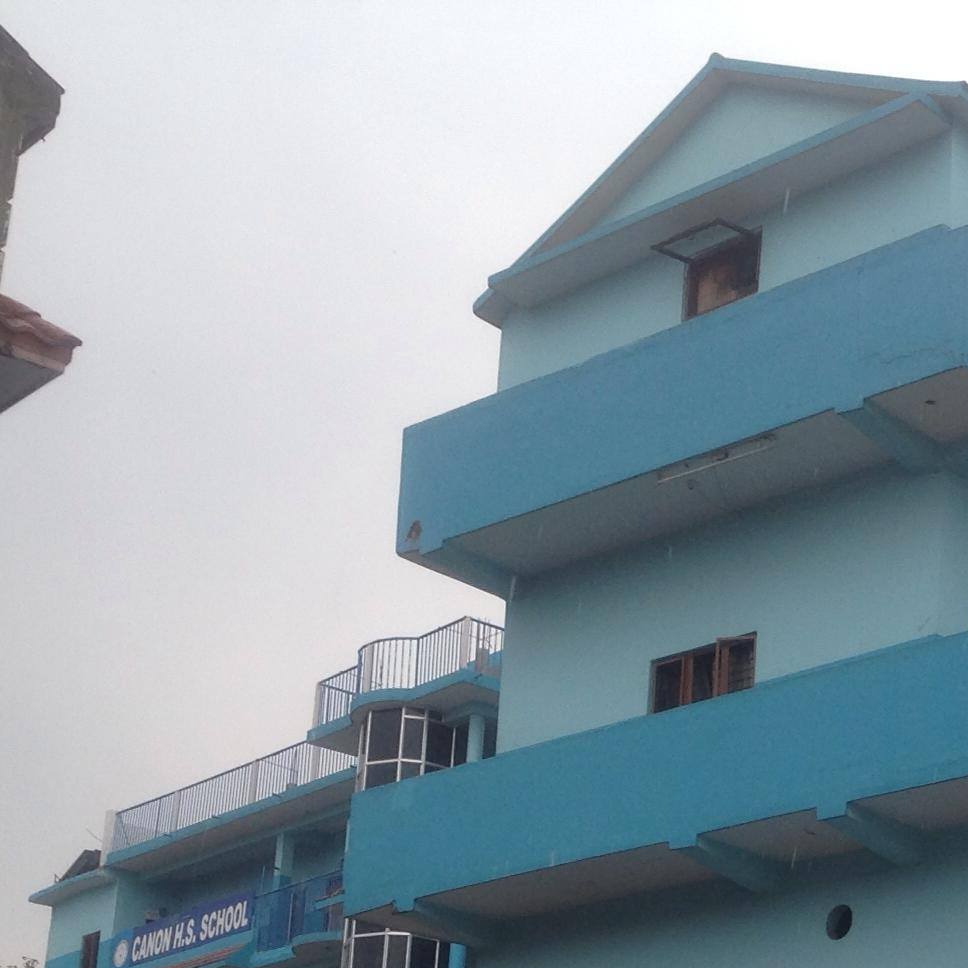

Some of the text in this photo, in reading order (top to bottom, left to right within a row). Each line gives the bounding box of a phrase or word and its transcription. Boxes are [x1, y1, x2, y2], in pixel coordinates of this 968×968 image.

[132, 900, 249, 963] CANON H.S. SCHOOL
